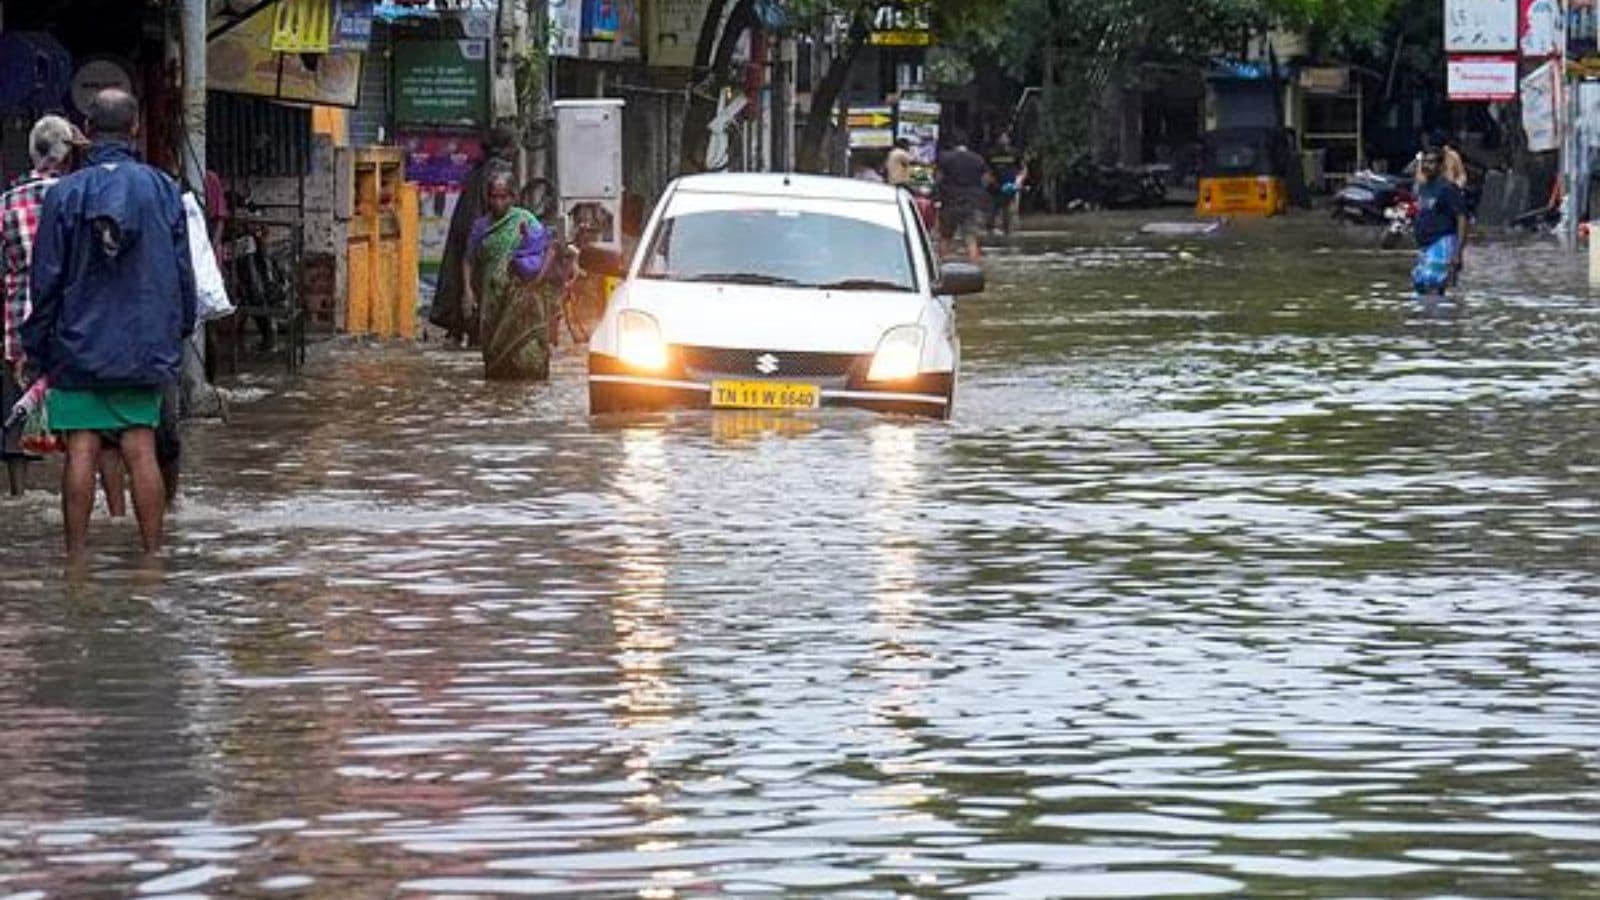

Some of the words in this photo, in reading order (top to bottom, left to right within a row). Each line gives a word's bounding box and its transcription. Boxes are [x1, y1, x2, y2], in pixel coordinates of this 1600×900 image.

[717, 388, 737, 403] TN
[742, 389, 757, 404] 11
[762, 390, 774, 405] W
